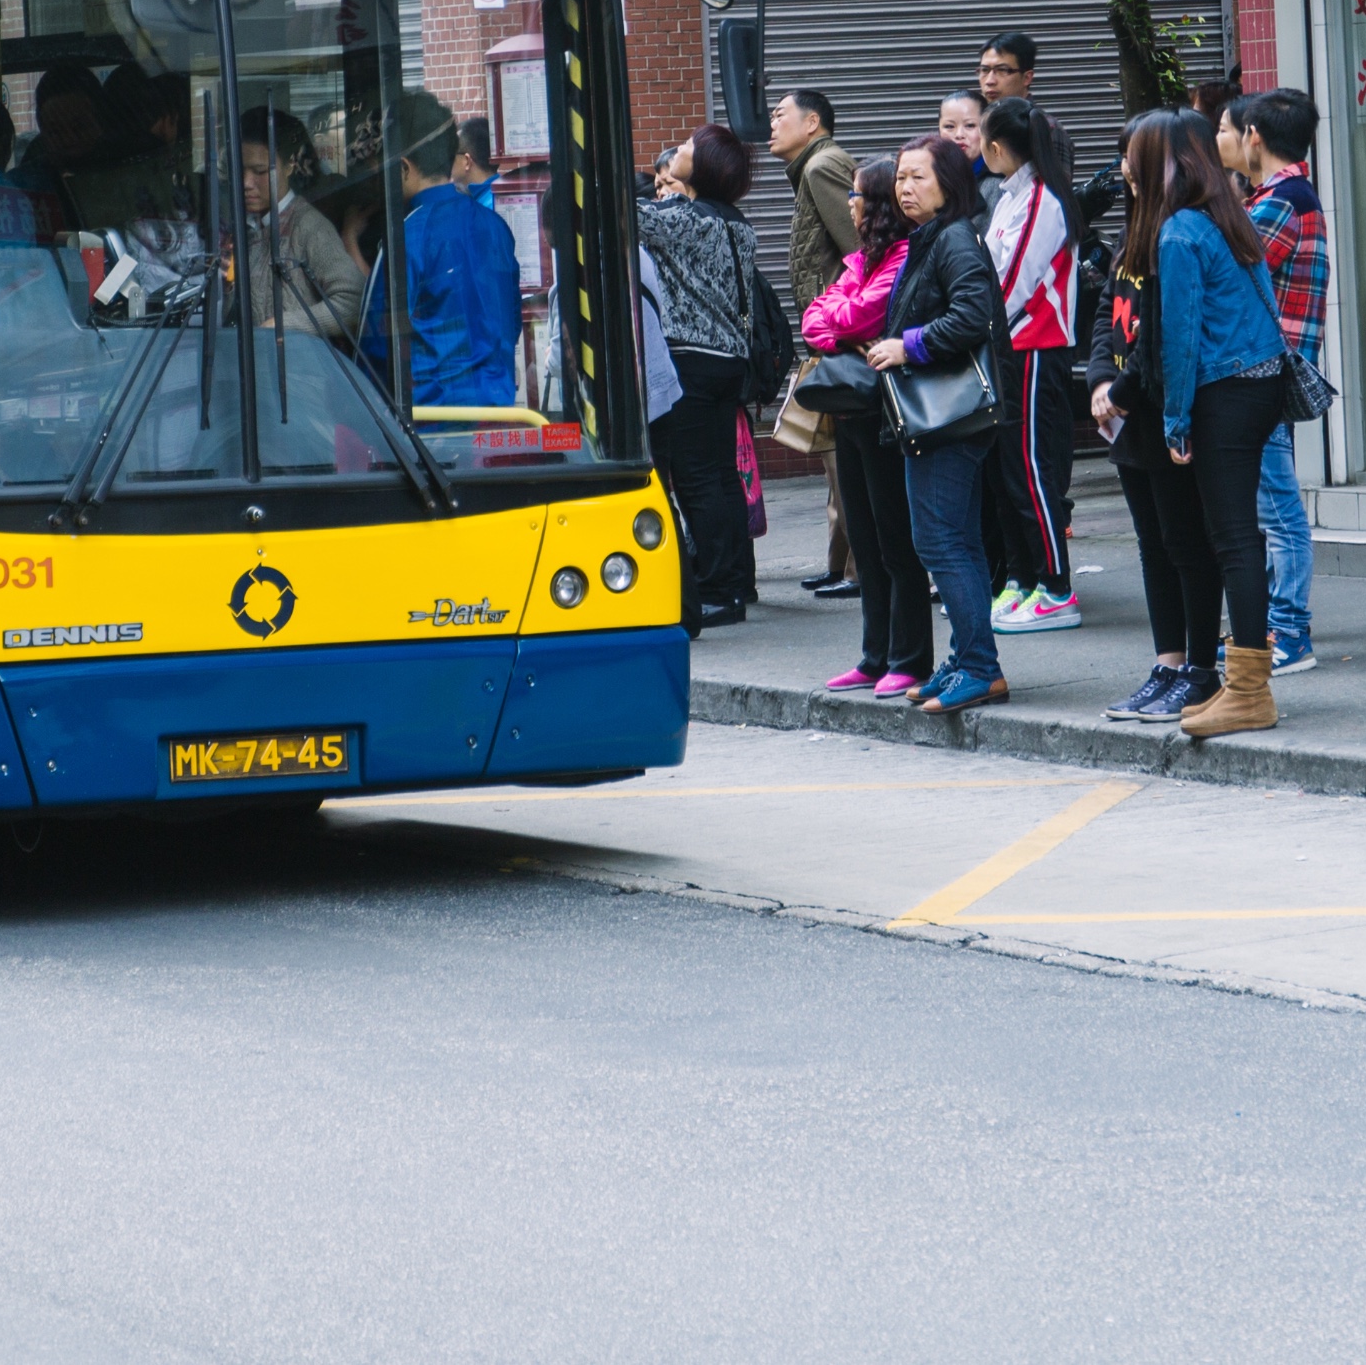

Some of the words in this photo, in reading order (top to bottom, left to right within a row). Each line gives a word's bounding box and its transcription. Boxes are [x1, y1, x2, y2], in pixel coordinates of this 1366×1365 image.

[472, 430, 539, 449] 不設找贖
[432, 597, 491, 626] Dart
[2, 622, 144, 649] DENNIS
[174, 734, 343, 777] MK-74-45
